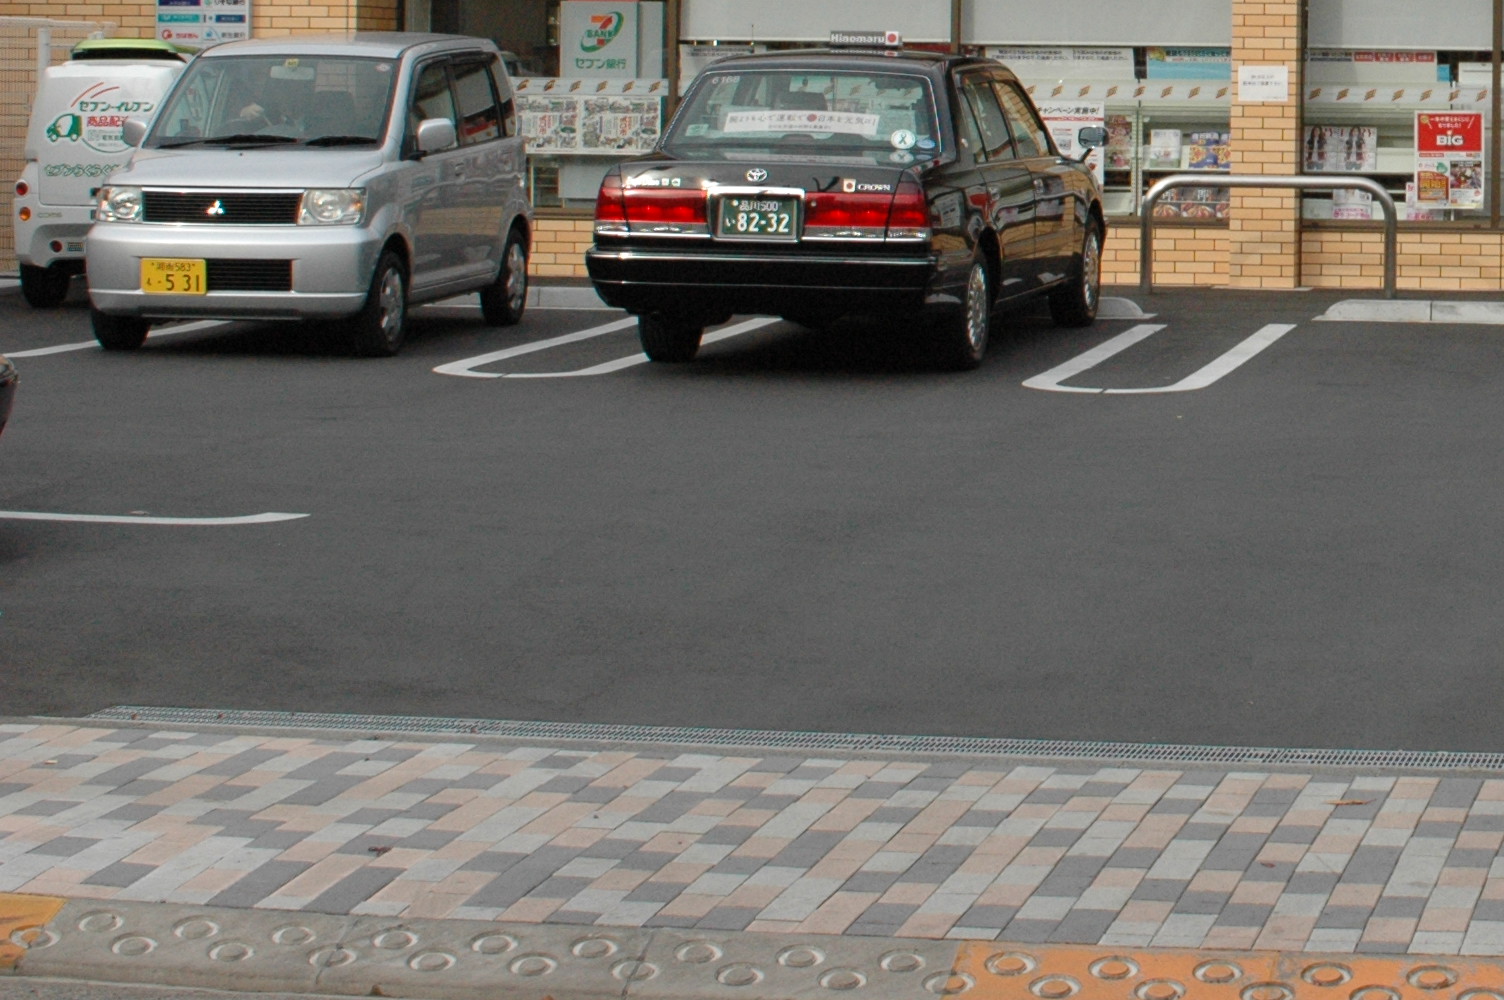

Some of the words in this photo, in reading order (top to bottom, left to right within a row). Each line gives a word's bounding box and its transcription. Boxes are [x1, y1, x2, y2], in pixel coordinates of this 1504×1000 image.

[830, 33, 885, 44] Hinomaru
[575, 57, 627, 70] セブン銀行
[856, 183, 891, 191] CROWN
[736, 213, 790, 233] 82-32
